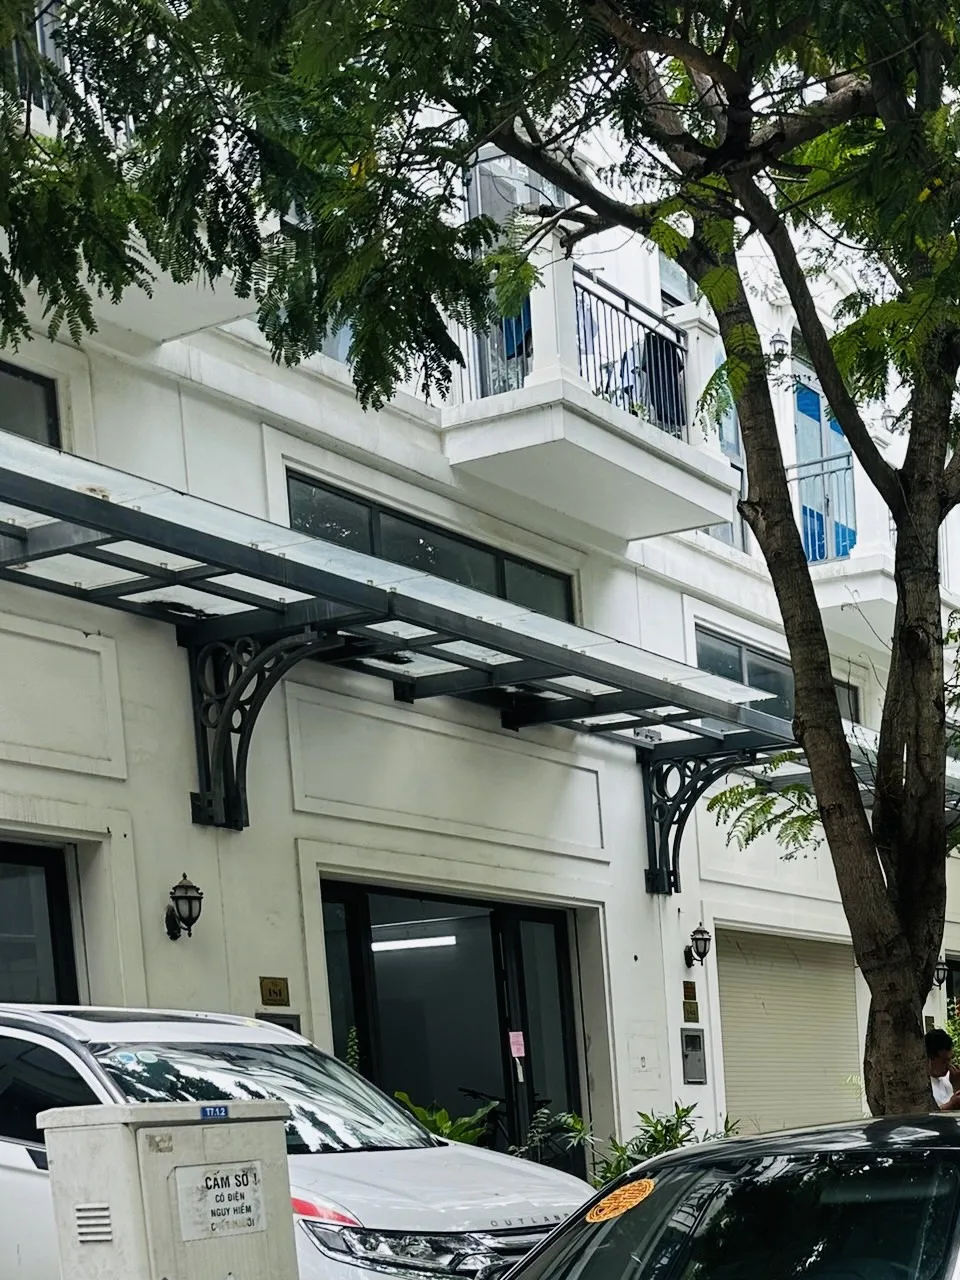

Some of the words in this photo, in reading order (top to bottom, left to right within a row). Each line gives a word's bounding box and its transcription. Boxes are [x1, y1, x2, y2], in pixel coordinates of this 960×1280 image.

[205, 1170, 231, 1190] CẤM
[215, 1192, 225, 1203] CÓ
[227, 1191, 245, 1202] ĐIỆN
[211, 1207, 231, 1217] NGUY
